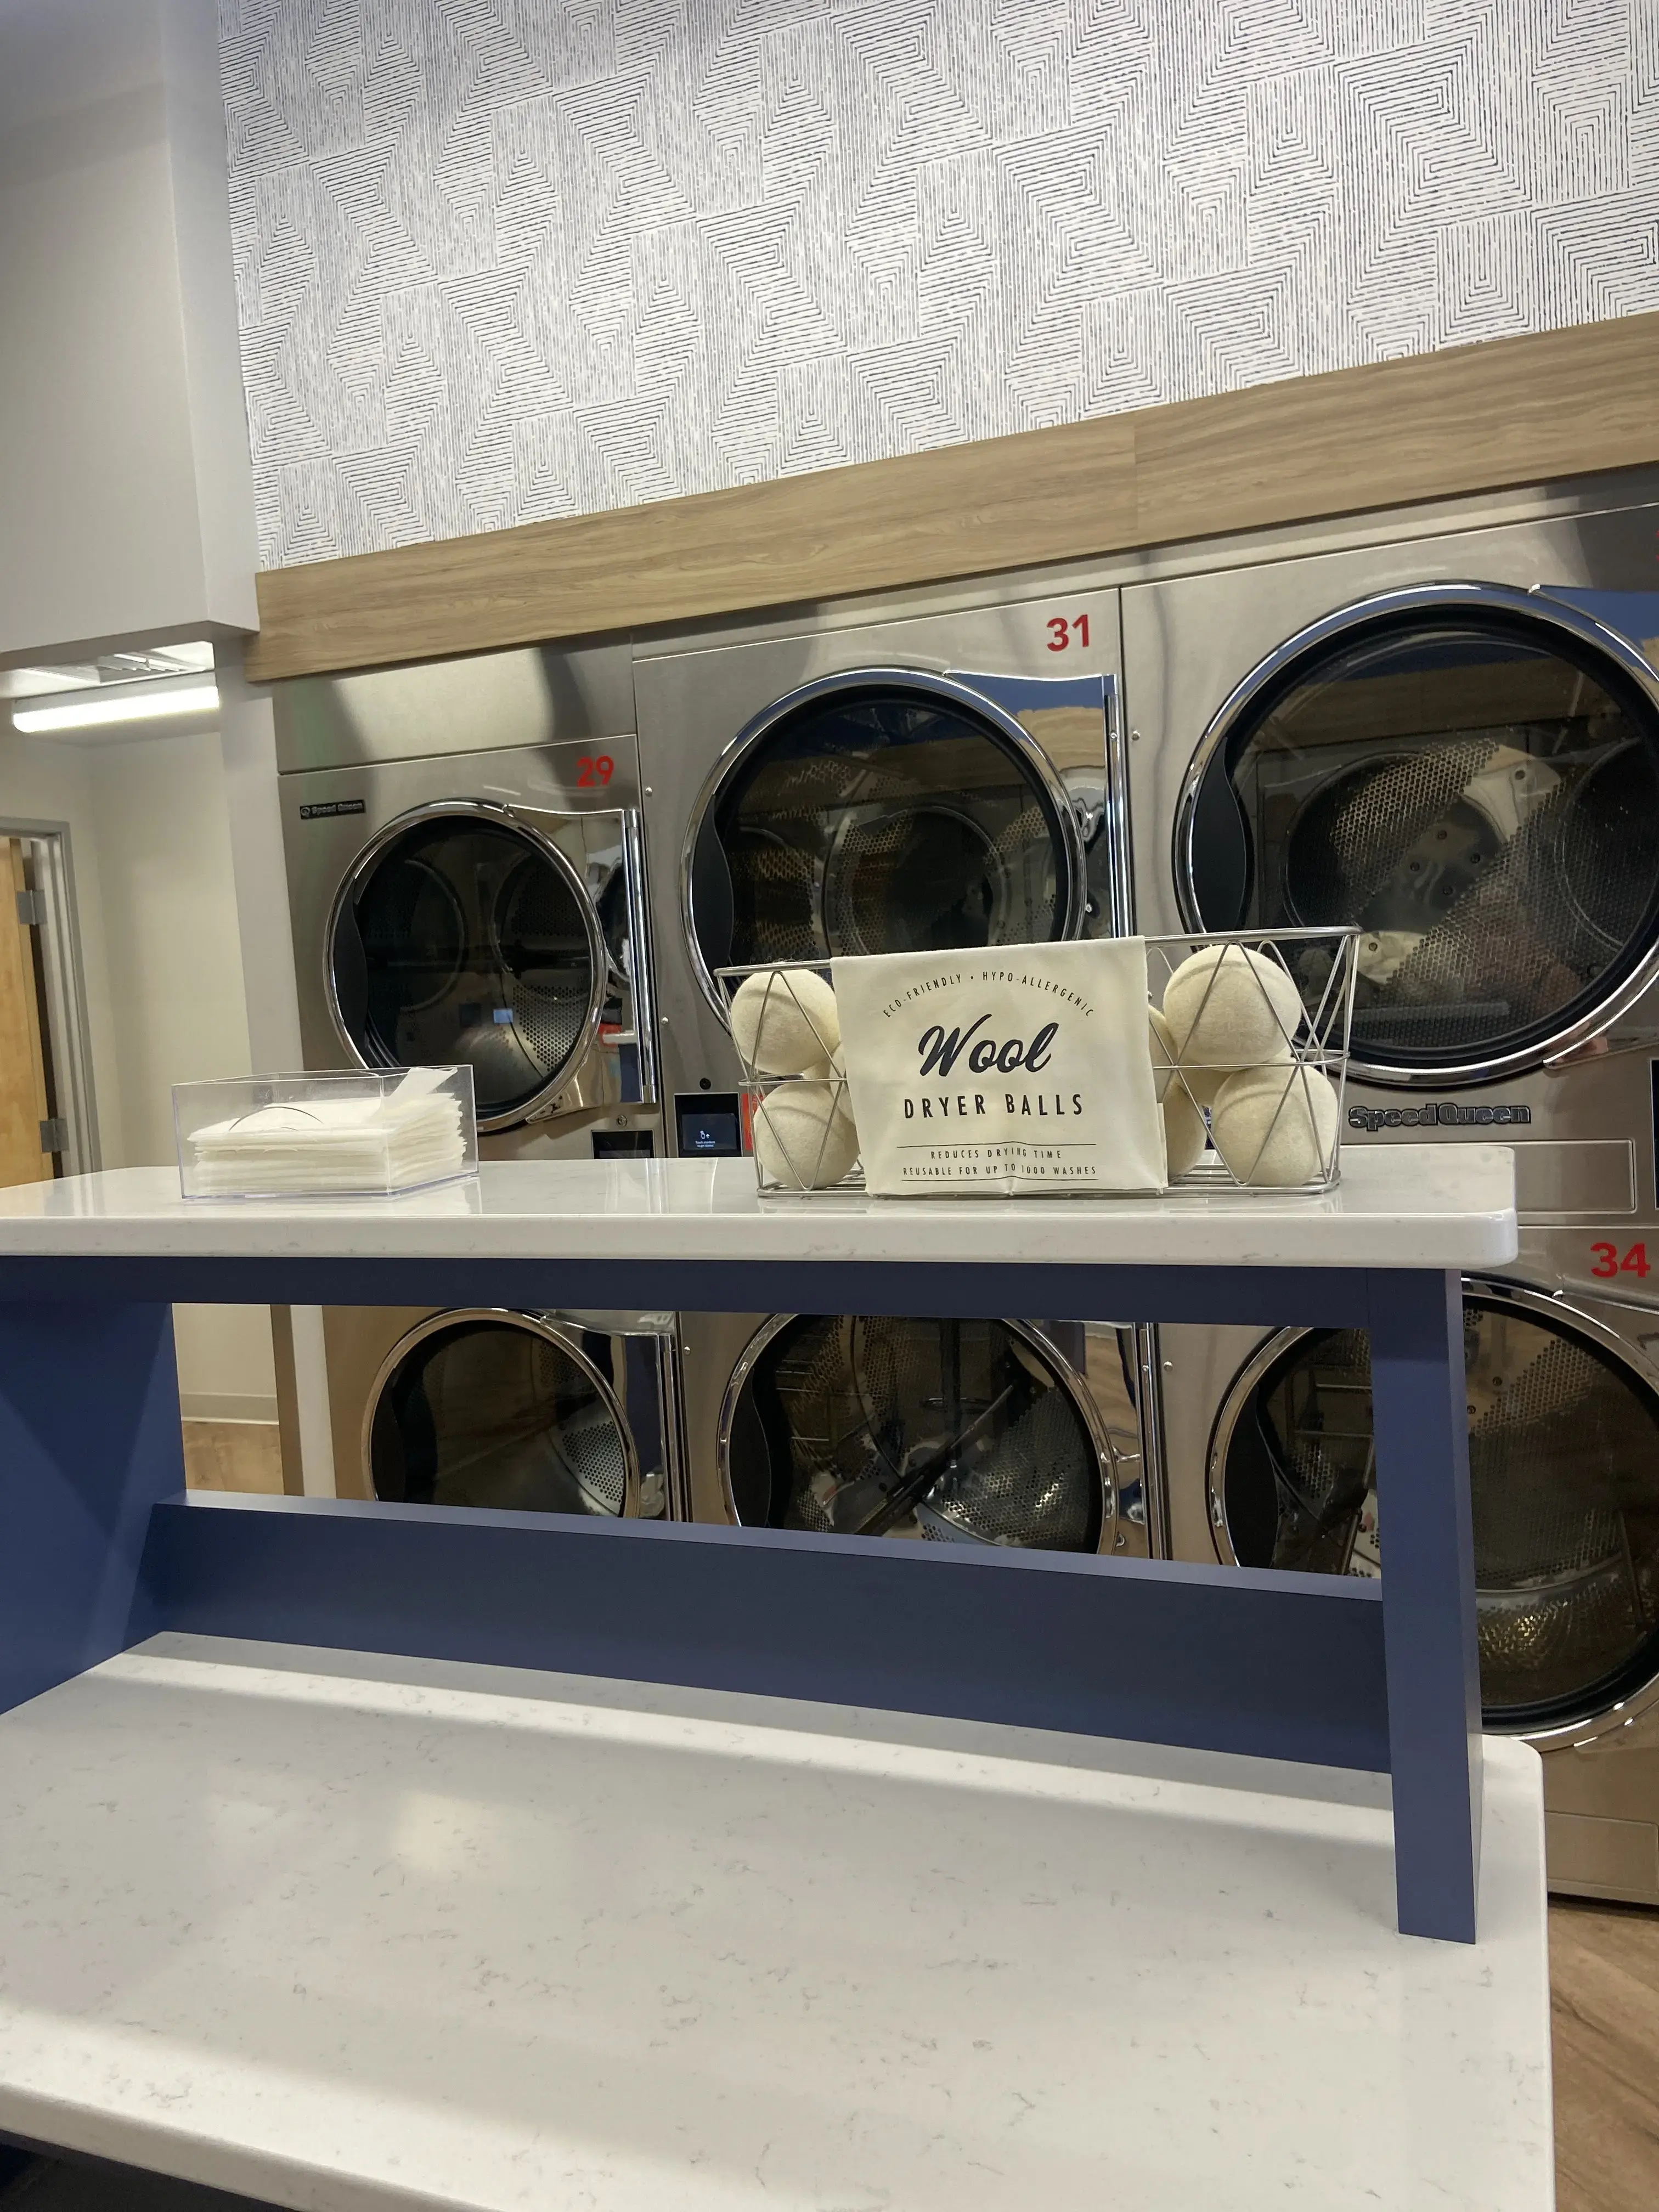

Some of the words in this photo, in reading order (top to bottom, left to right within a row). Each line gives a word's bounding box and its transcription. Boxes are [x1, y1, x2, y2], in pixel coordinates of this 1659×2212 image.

[1046, 614, 1089, 652] 31
[577, 755, 614, 788] 29
[883, 974, 961, 1018] ECO-FRIENDLY
[983, 971, 1093, 1017] HYPO-ALLERGENIC
[918, 1013, 1059, 1077] Wool
[904, 1094, 986, 1119] DRYER
[1005, 1093, 1082, 1115] BALLS
[1348, 1103, 1438, 1132] Speed
[1438, 1102, 1531, 1125] Queen
[903, 1167, 952, 1175] REUSABLE
[958, 1166, 978, 1175] FOR
[985, 1165, 998, 1174] UP
[1004, 1163, 1015, 1172] TO
[1022, 1164, 1045, 1175] 1000
[1053, 1166, 1096, 1175] WASHES
[930, 1149, 979, 1159] REDUCES
[987, 1147, 1026, 1158] DRYING
[1034, 1150, 1062, 1159] TIME
[1590, 1242, 1651, 1278] 34
